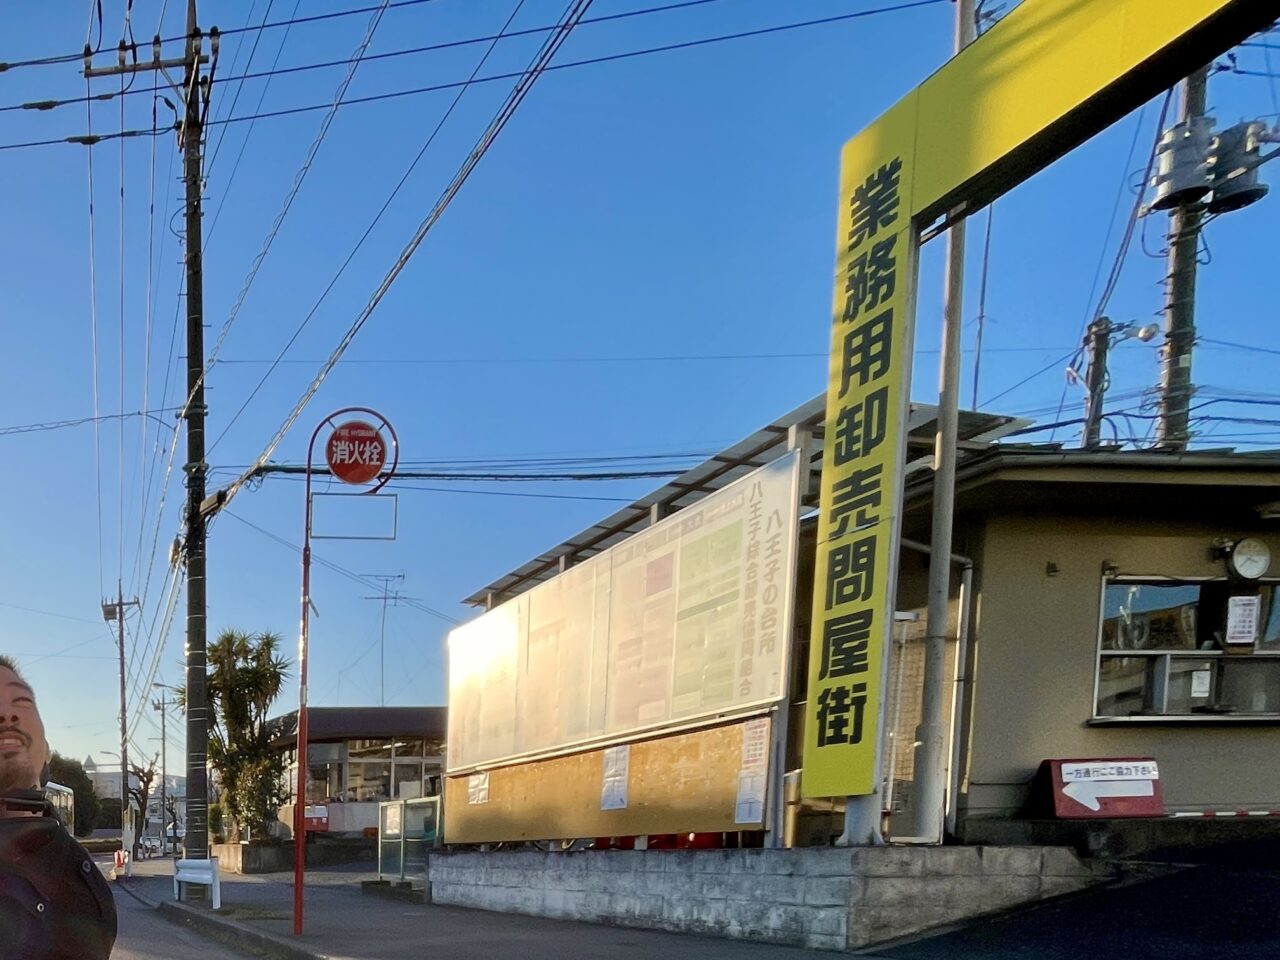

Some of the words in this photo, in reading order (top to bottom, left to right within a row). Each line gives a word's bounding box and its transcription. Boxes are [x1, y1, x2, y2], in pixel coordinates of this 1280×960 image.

[331, 440, 382, 464] 消火栓
[817, 156, 903, 747] 業務用卸売問屋街
[759, 508, 784, 656] 八王子の台所
